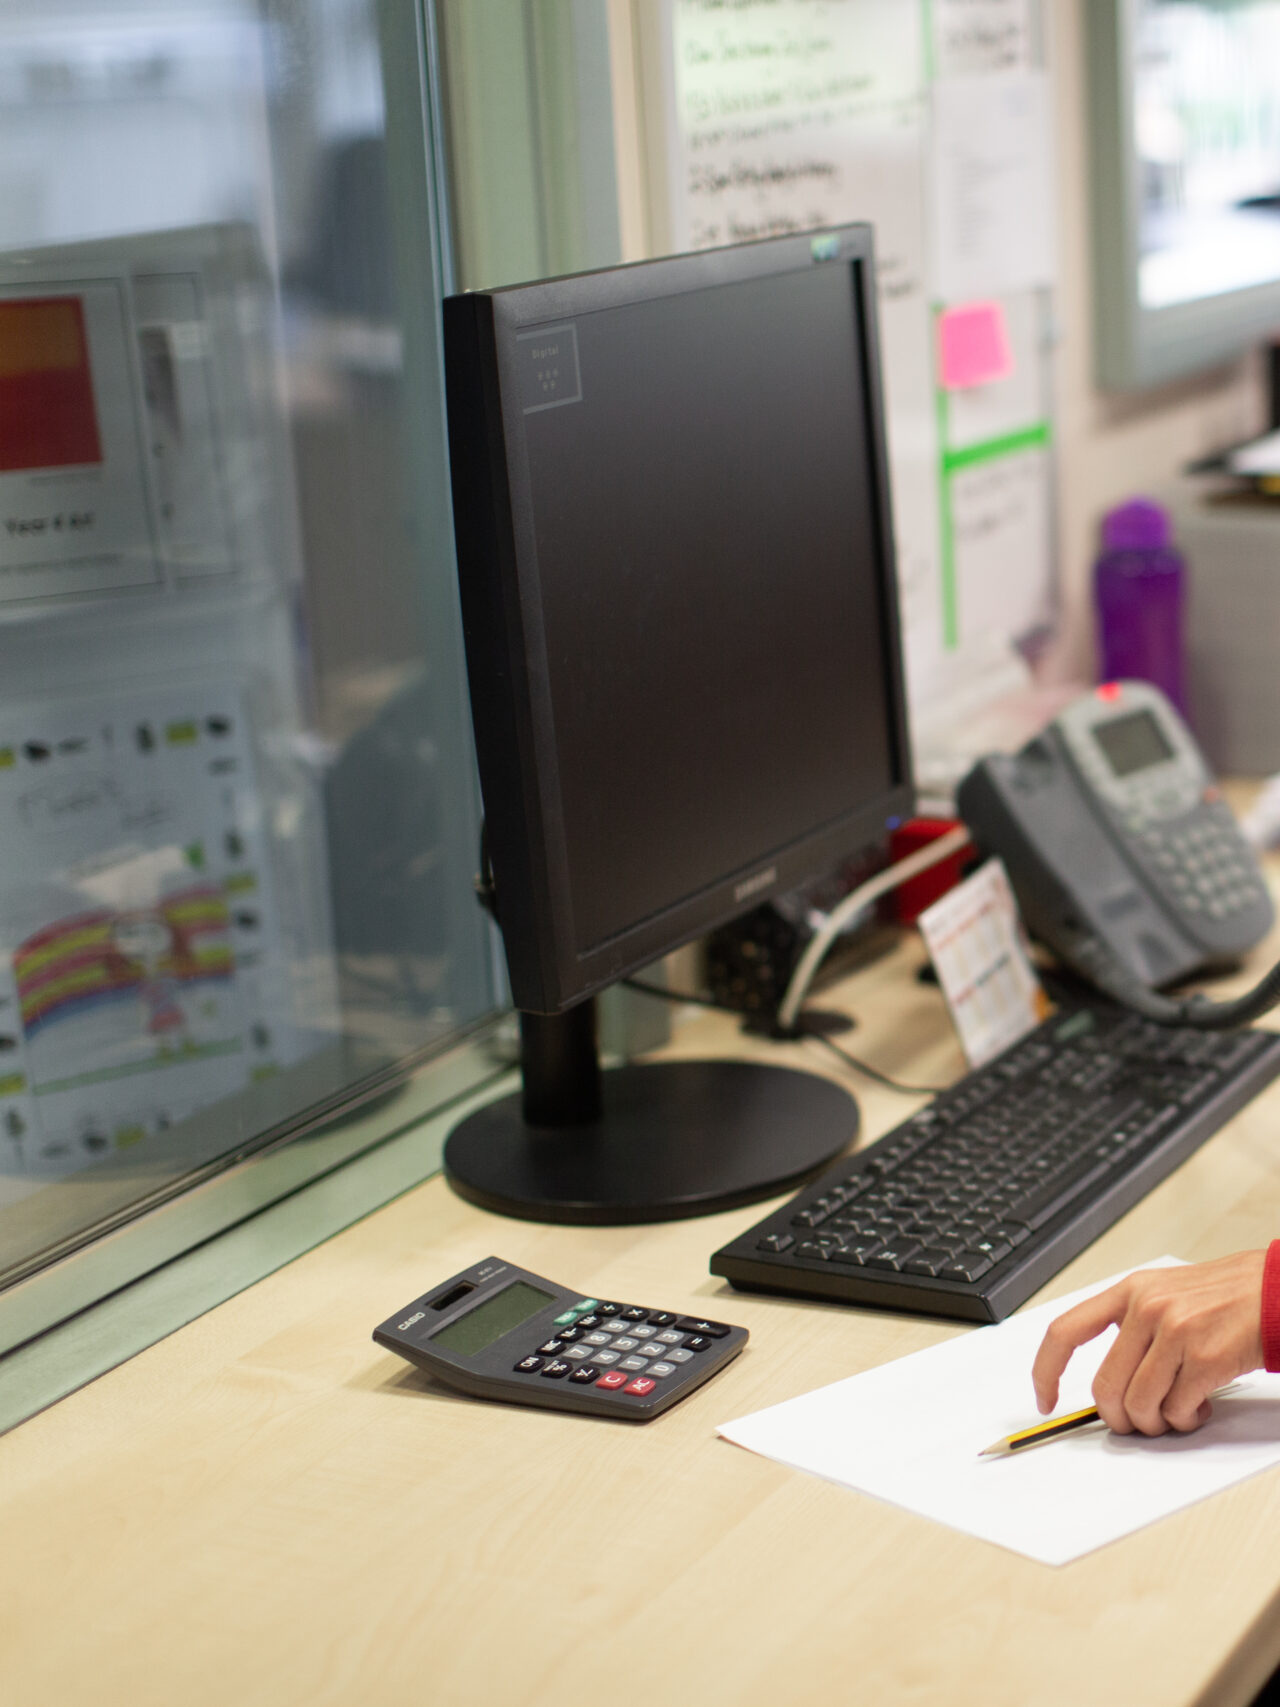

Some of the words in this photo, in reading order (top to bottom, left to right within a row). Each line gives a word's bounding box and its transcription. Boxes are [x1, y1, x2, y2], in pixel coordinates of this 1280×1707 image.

[398, 1311, 426, 1331] CASIO
[570, 1347, 585, 1355] 7
[590, 1333, 606, 1343] 8
[608, 1321, 624, 1331] 9
[599, 1352, 614, 1362] 4
[617, 1338, 633, 1347] 5
[634, 1326, 651, 1335] 6
[520, 1356, 540, 1368] ON
[605, 1374, 622, 1384] C
[627, 1359, 642, 1367] 1
[644, 1345, 661, 1354] 2
[662, 1332, 679, 1341] 3
[632, 1378, 651, 1391] AC
[655, 1364, 671, 1373] 0
